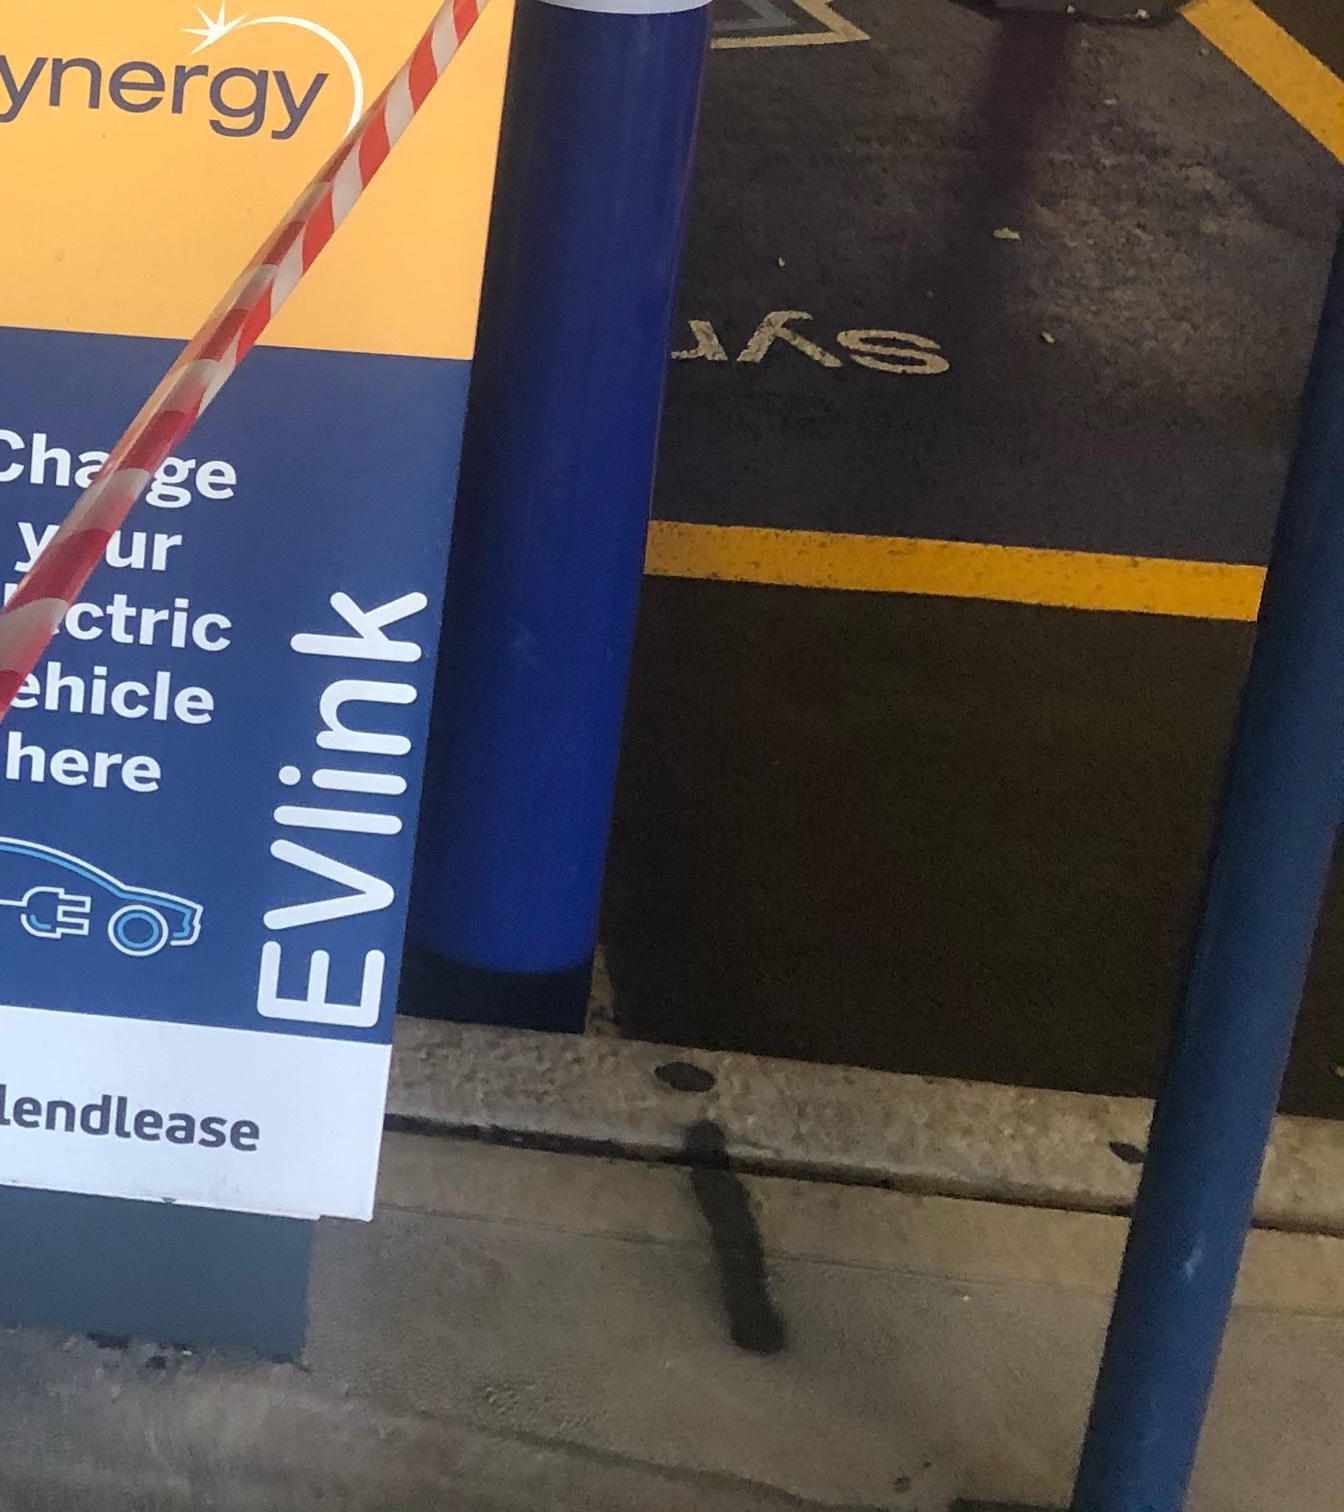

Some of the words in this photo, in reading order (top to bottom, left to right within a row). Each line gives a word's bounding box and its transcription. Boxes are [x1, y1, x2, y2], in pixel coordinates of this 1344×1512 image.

[14, 521, 183, 572] yur
[9, 660, 215, 725] ehicle
[5, 730, 162, 793] here
[257, 591, 429, 1030] EVlink
